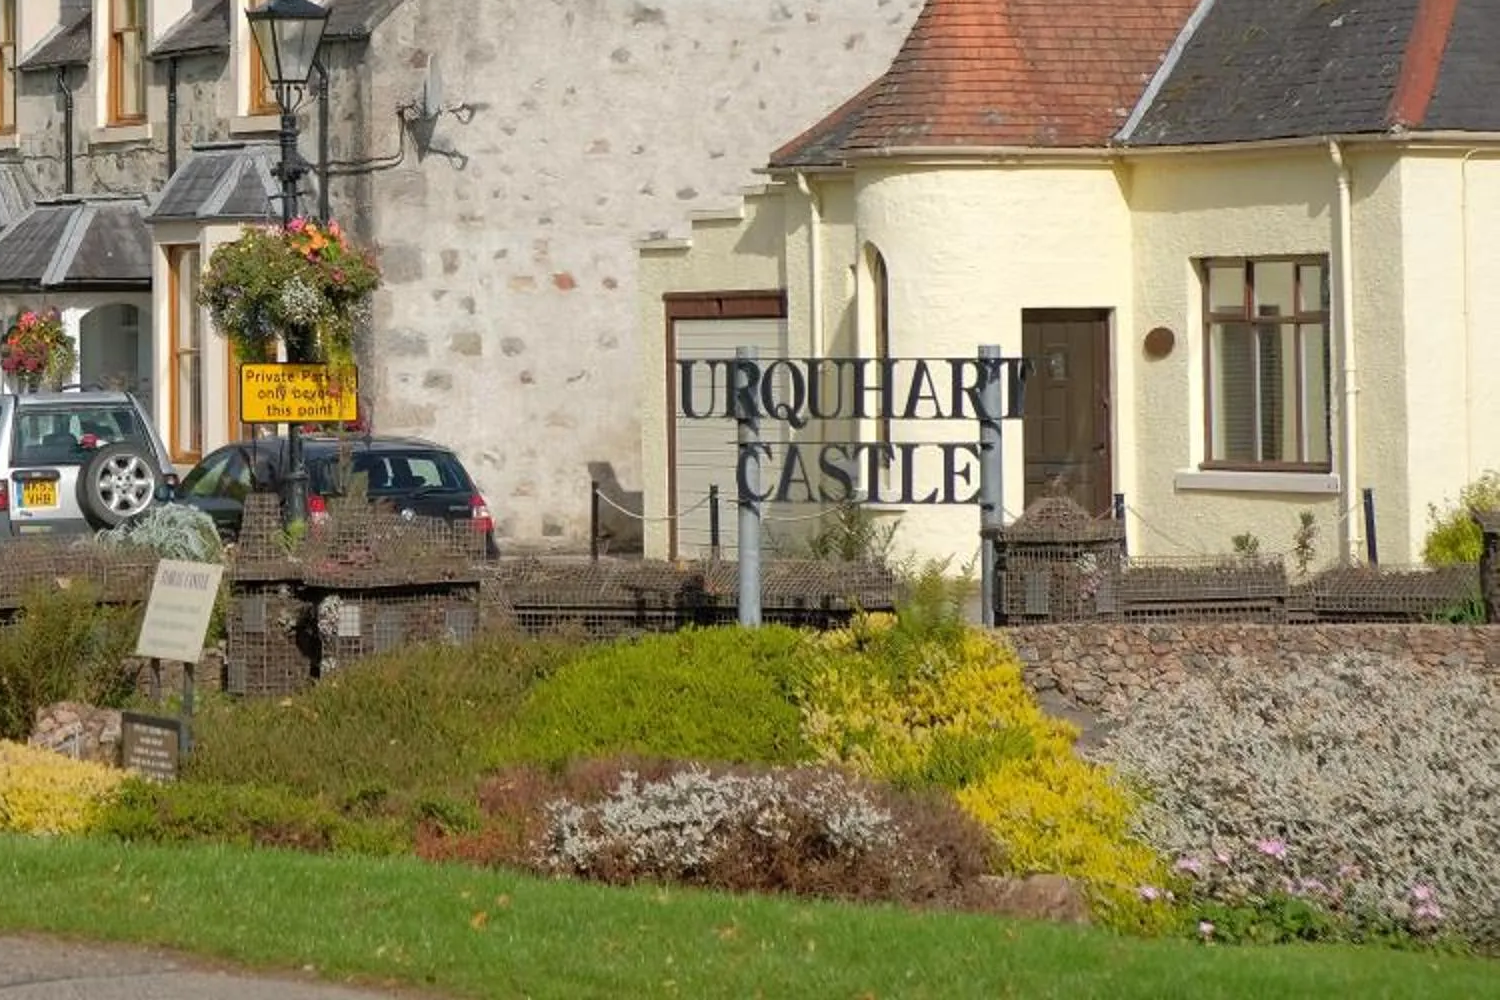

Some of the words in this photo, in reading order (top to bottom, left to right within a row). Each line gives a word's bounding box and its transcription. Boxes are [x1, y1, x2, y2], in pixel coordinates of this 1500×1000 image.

[246, 370, 294, 382] Private
[258, 386, 287, 401] only
[678, 357, 1034, 429] URQUHART
[267, 404, 291, 416] this
[298, 404, 332, 418] point
[735, 442, 982, 504] CASTLE
